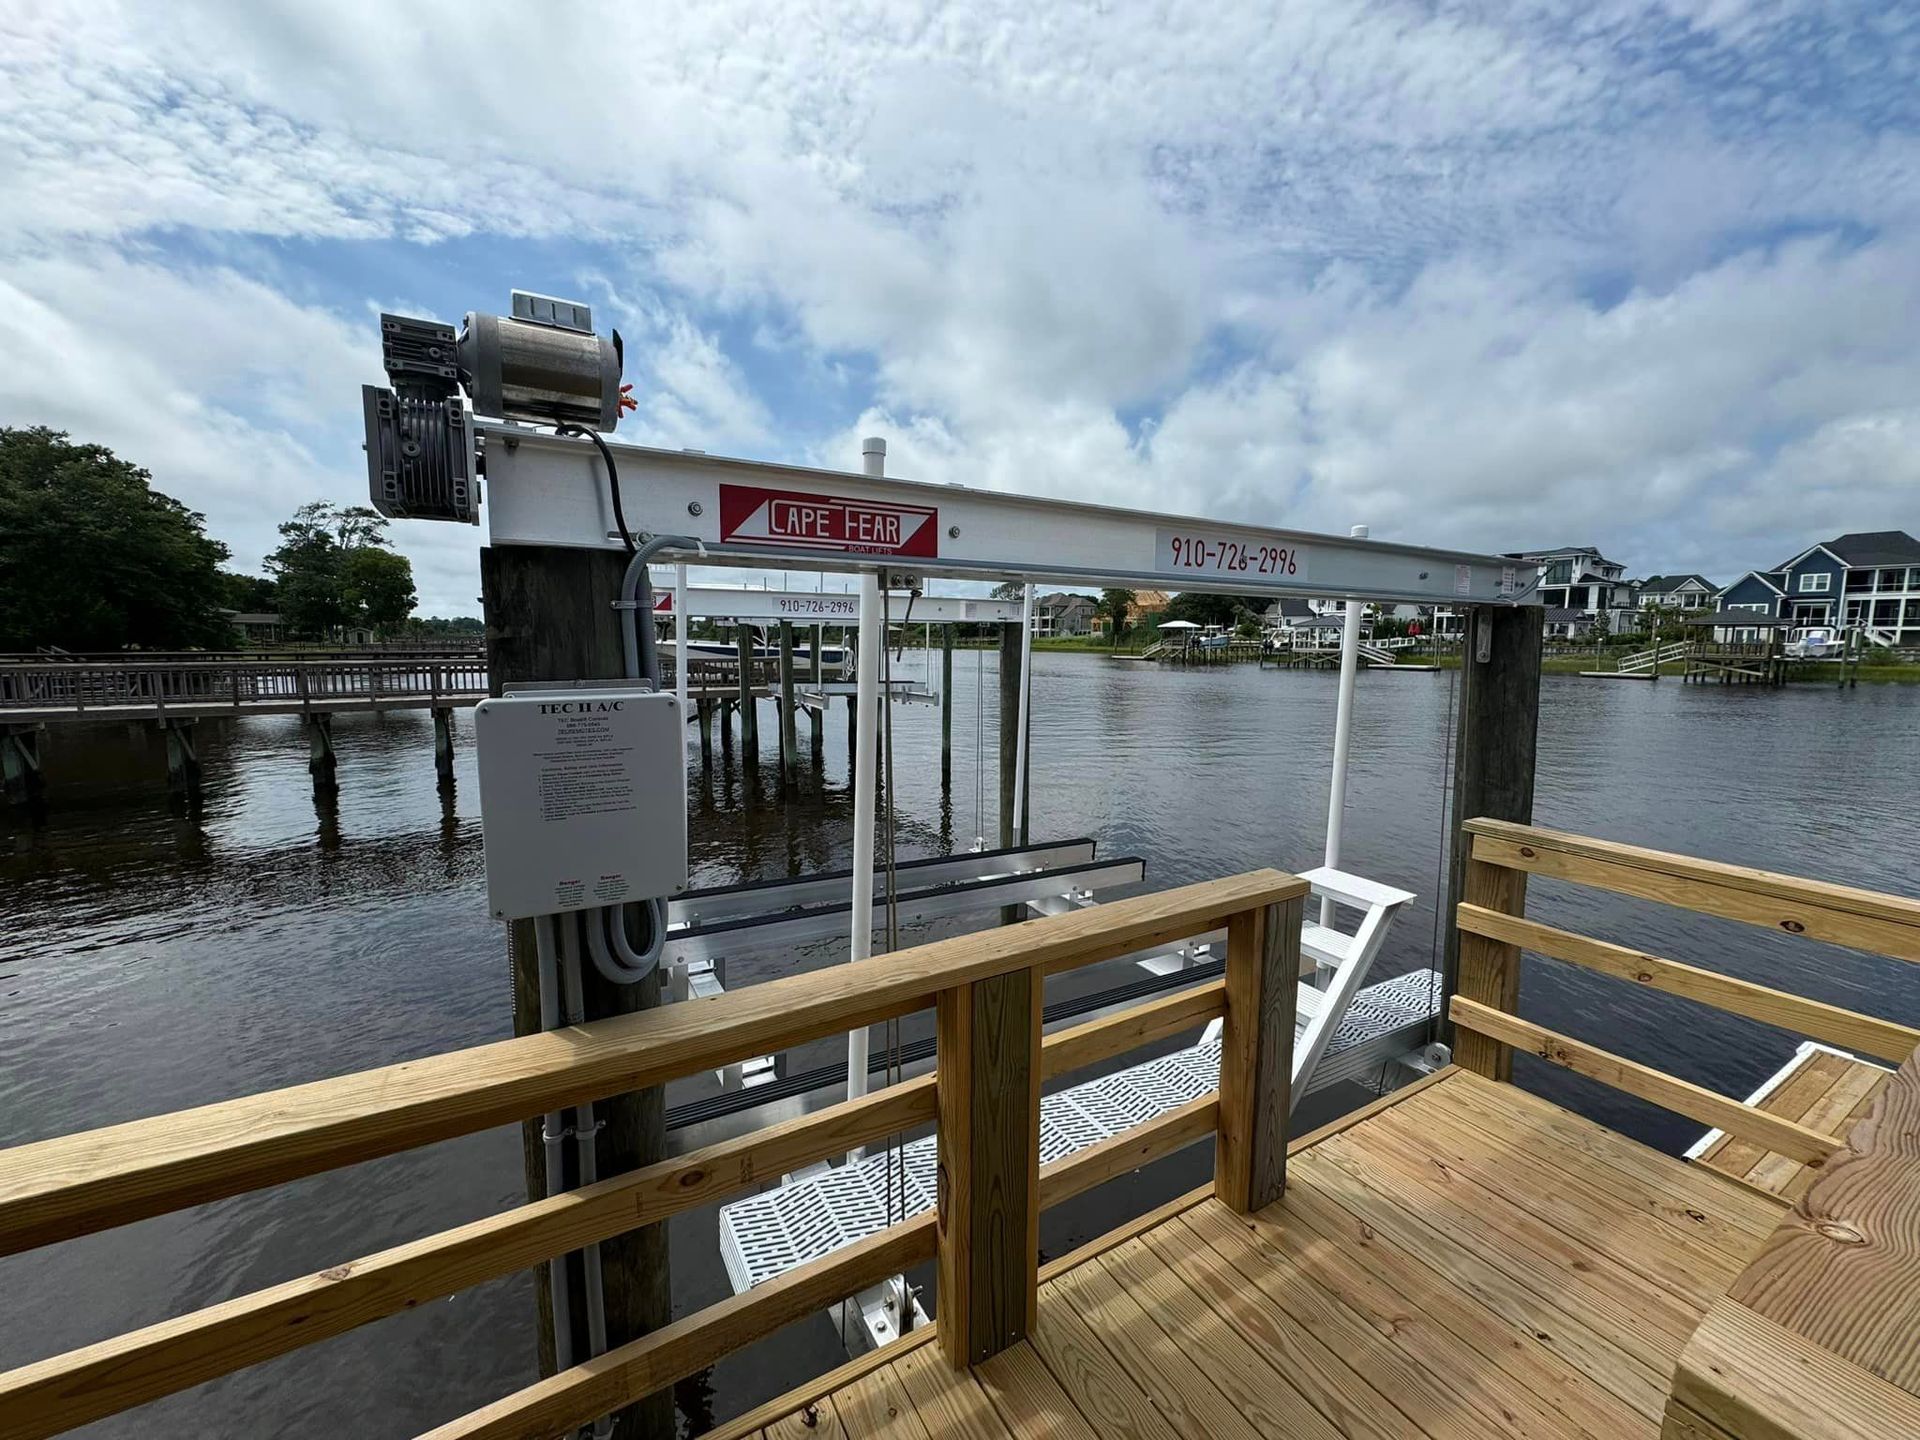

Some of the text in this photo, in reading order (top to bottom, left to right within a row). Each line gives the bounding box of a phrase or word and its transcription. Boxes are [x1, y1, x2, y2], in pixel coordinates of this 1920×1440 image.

[771, 500, 898, 543] CAPE FEAR
[848, 545, 893, 555] BOAT LIFTS
[1172, 537, 1297, 575] 910-726-2996
[780, 600, 854, 614] 910-726-2996
[537, 701, 625, 714] TEC II A/C
